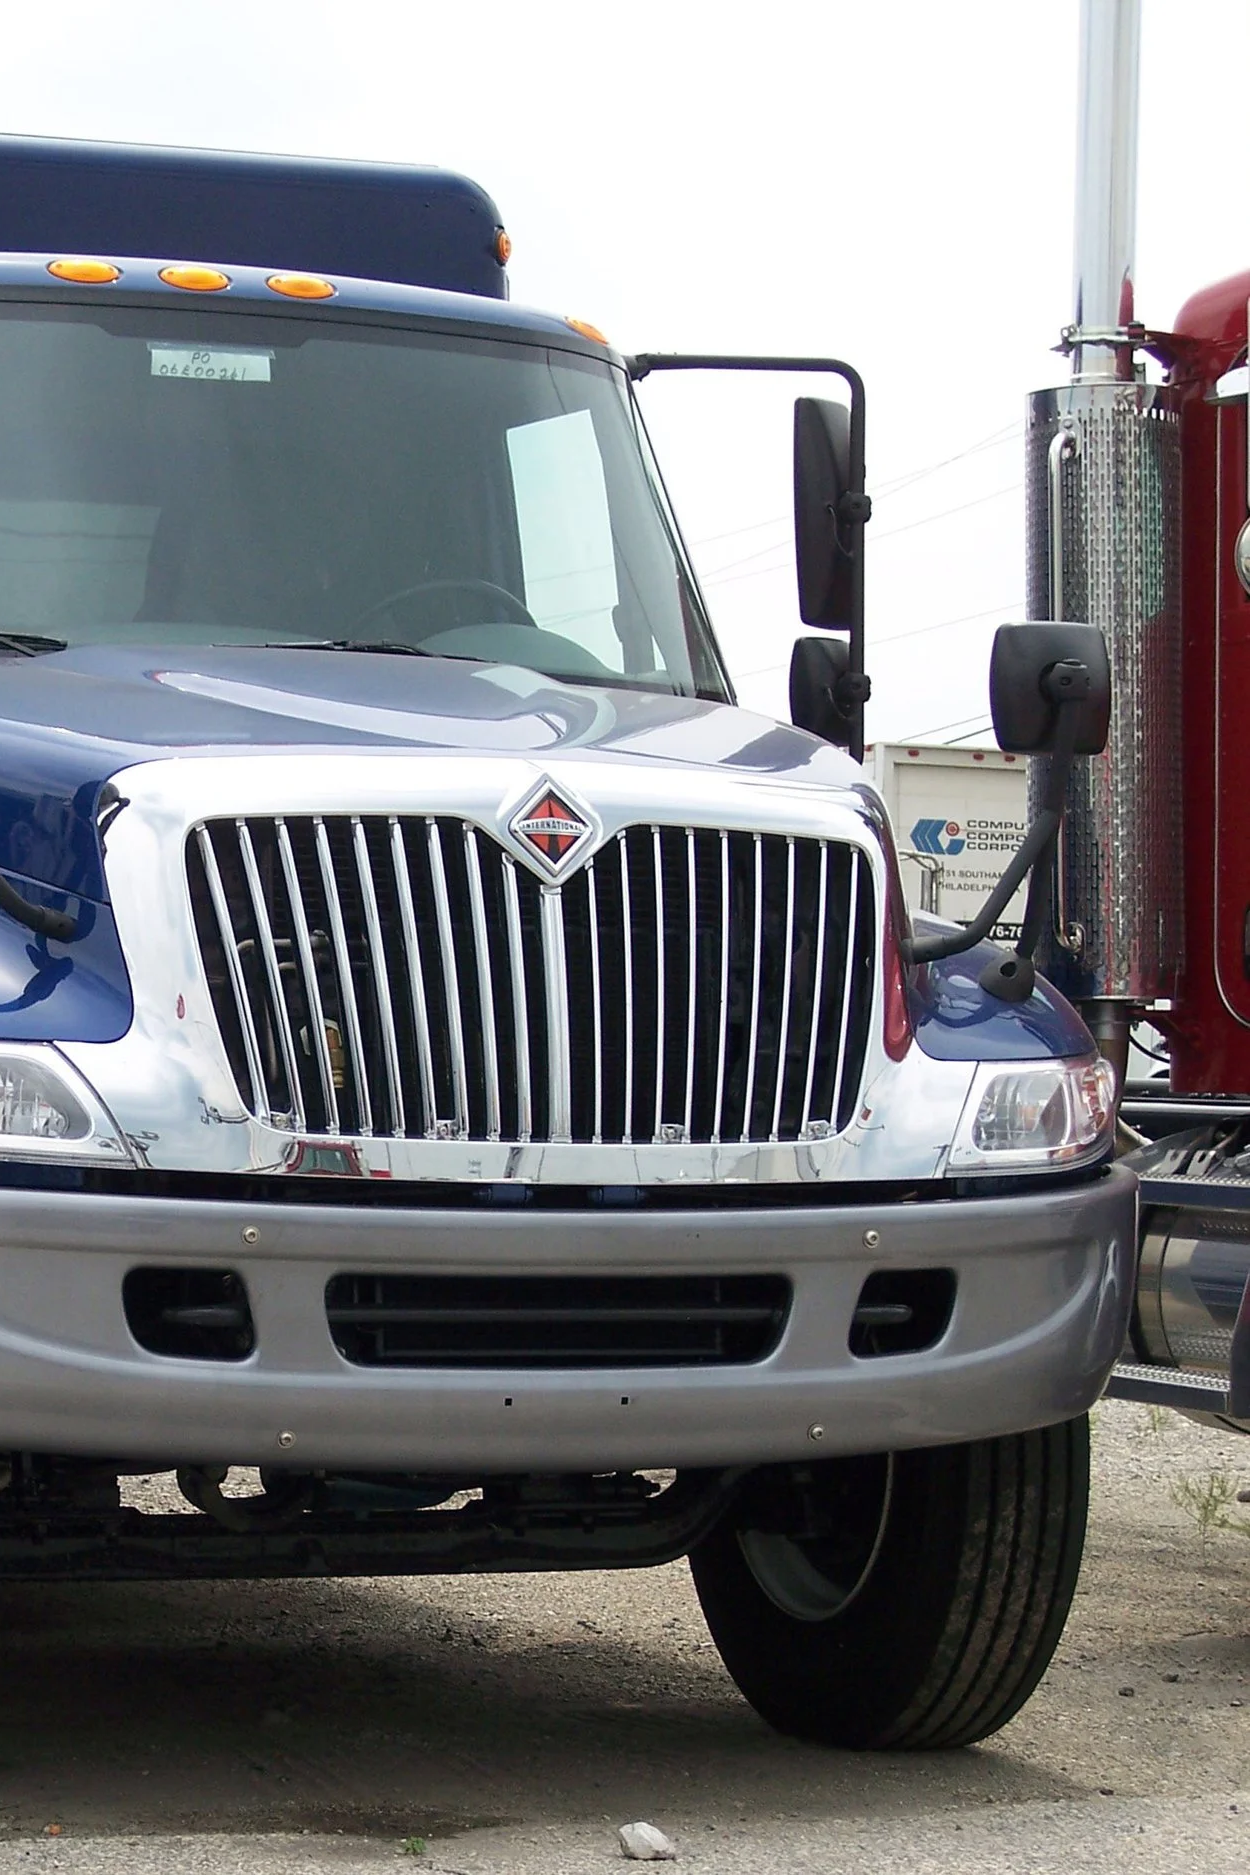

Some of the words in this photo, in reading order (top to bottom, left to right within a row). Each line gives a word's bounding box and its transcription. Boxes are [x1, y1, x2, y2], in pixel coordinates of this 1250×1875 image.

[191, 352, 211, 364] PO
[522, 820, 582, 831] INTERNATIONAL
[967, 820, 1027, 831] COMPU
